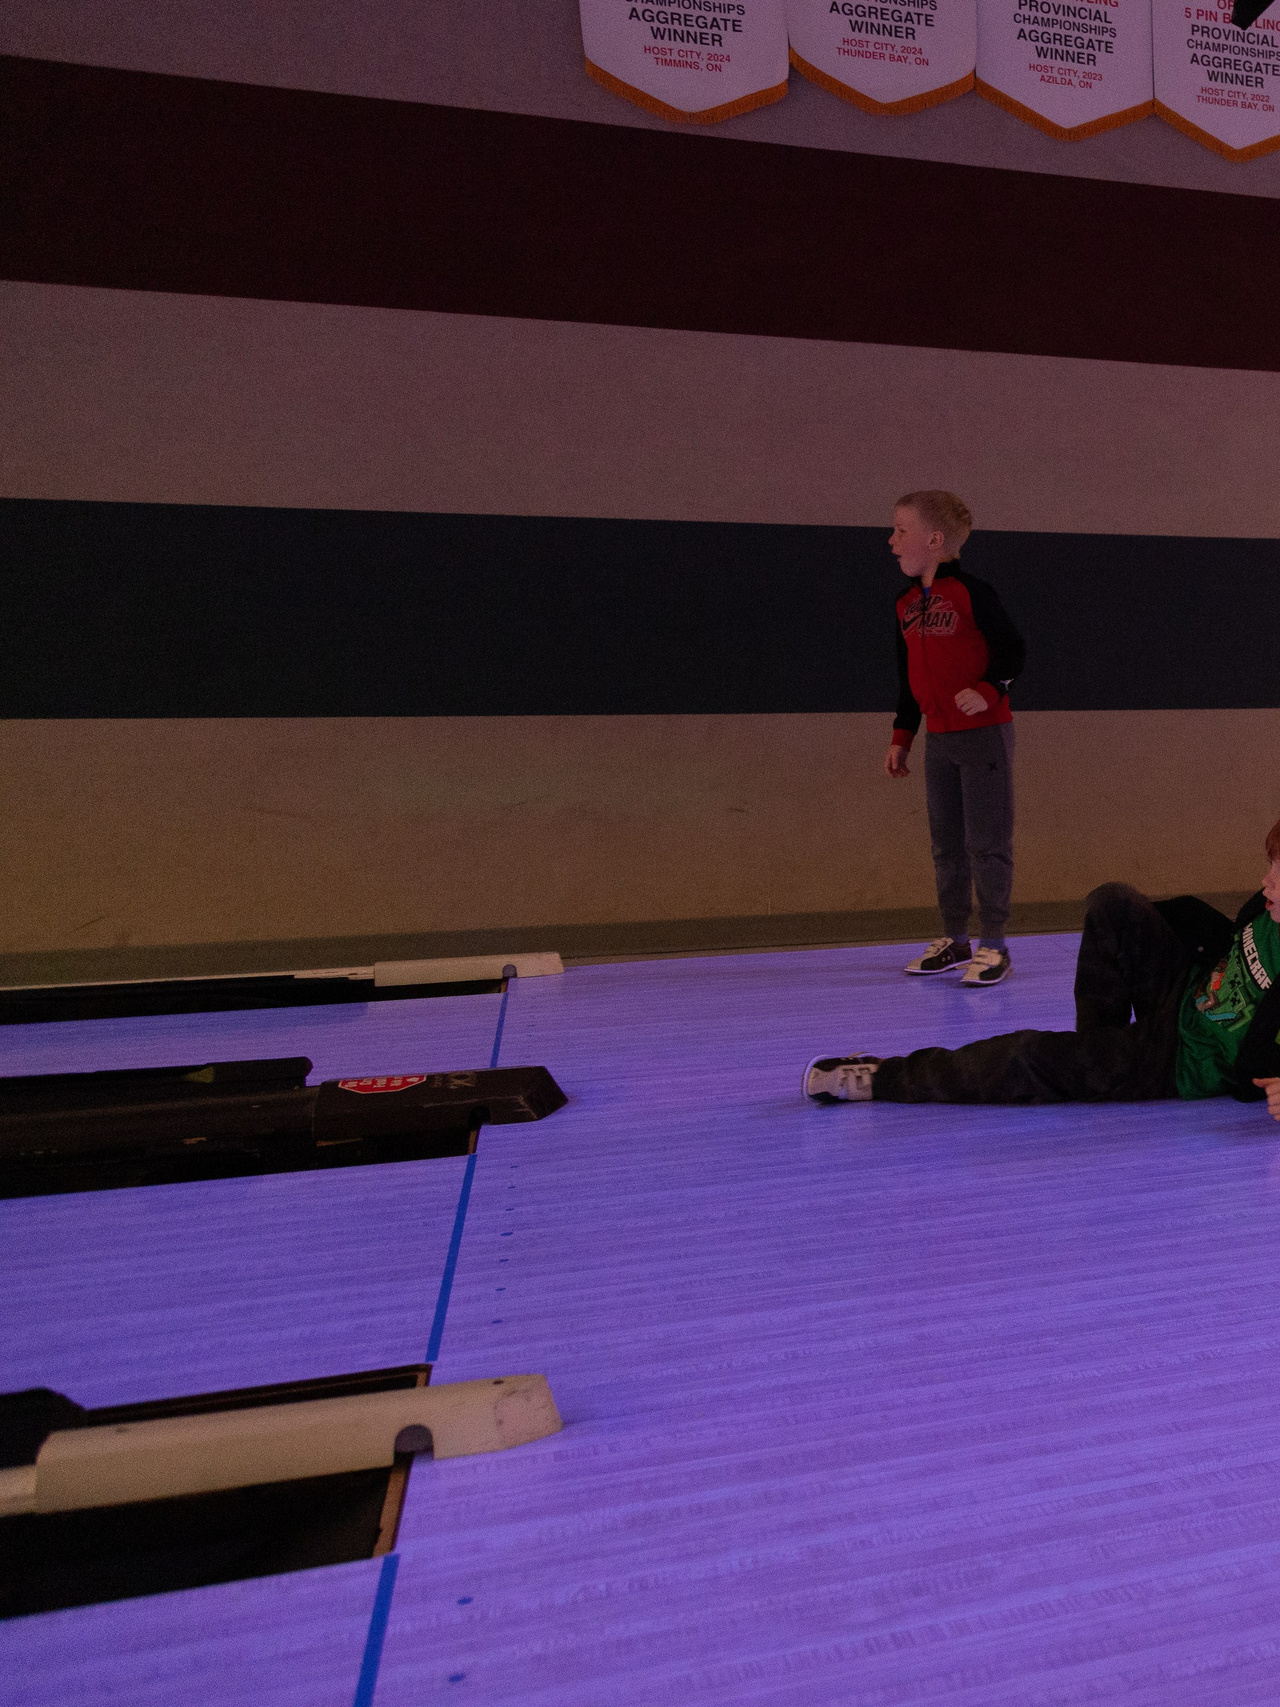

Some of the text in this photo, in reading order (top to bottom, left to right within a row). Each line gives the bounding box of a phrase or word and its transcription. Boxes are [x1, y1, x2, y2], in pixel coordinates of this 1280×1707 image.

[629, 7, 743, 33] AGGREGATE
[830, 1, 935, 27] AGGREGATE
[1018, 0, 1112, 24] PROVINCIAL
[1184, 7, 1191, 18] 5
[1196, 9, 1218, 23] PIN
[848, 19, 916, 40] WINNER
[1013, 13, 1117, 38] CHAMPIONSHIPS
[1191, 24, 1279, 48] PROVINCIAL
[650, 26, 723, 47] WINNER
[842, 38, 923, 55] HOST CITY, 2024
[1017, 28, 1114, 54] AGGREGATE
[643, 45, 731, 62] HOST CITY, 2024
[836, 47, 929, 66] THUNDER BAY, ON
[1035, 45, 1097, 66] WINNER
[654, 57, 722, 72] TIMMINS, ON
[1028, 63, 1103, 81] HOST CITY, 2023
[1190, 53, 1280, 76] AGGREGATE
[1039, 74, 1093, 89] AZILDA, ON
[1206, 69, 1264, 89] WINNER
[1196, 95, 1275, 112] THUNDER BAY, ON
[1201, 86, 1248, 101] HOST CITY,
[1242, 922, 1273, 990] MINECRAF
